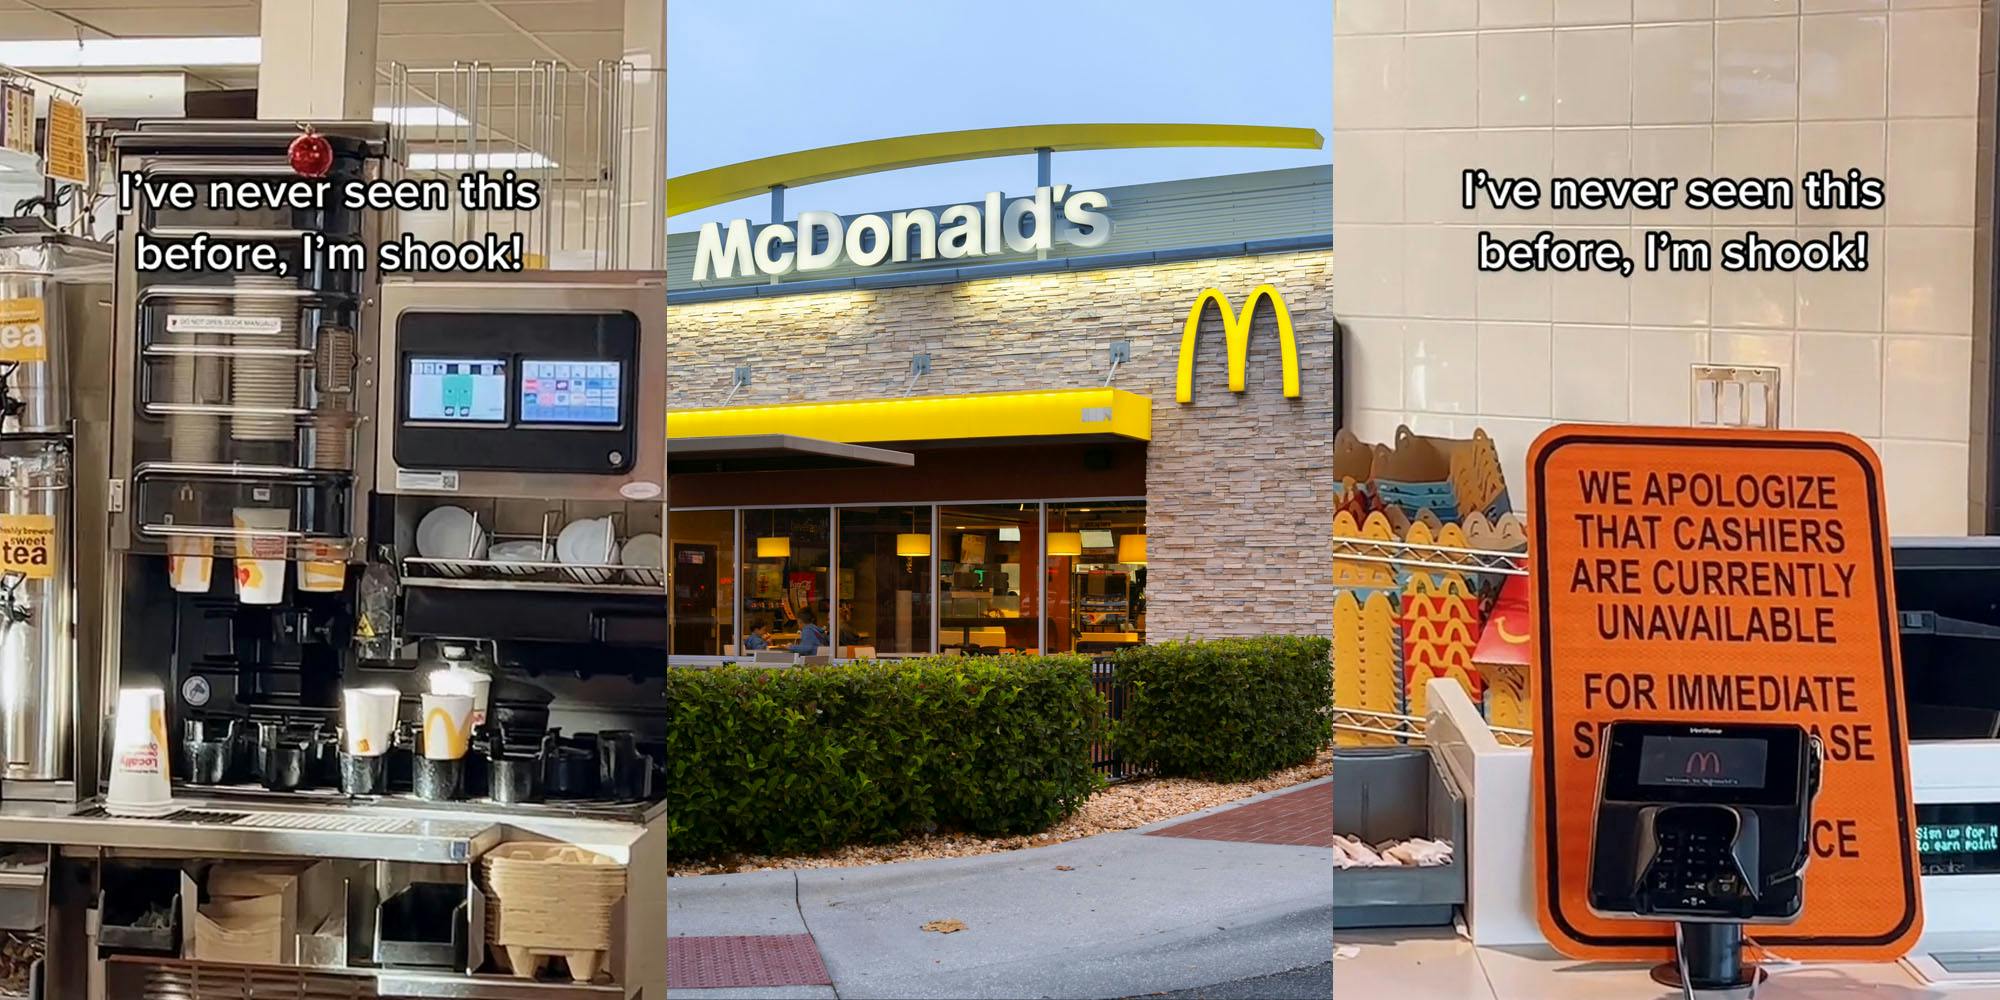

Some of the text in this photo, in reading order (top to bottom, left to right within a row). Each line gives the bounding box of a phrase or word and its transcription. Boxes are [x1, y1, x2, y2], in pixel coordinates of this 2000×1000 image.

[692, 183, 1113, 281] McDonald's
[0, 324, 43, 348] ea
[1578, 470, 1838, 510] WE APOLOGIZE
[2, 541, 48, 566] tea
[10, 536, 46, 546] sweet
[1575, 514, 1846, 554] THAT CASHIERS
[1570, 558, 1857, 598] ARE CURRENTLY
[1597, 604, 1837, 644] UNAVAILABLE
[1584, 673, 1858, 712] FOR IMMEDIATE
[1915, 827, 1942, 839] Sign
[1965, 826, 1985, 839] for
[1934, 841, 1960, 851] earn
